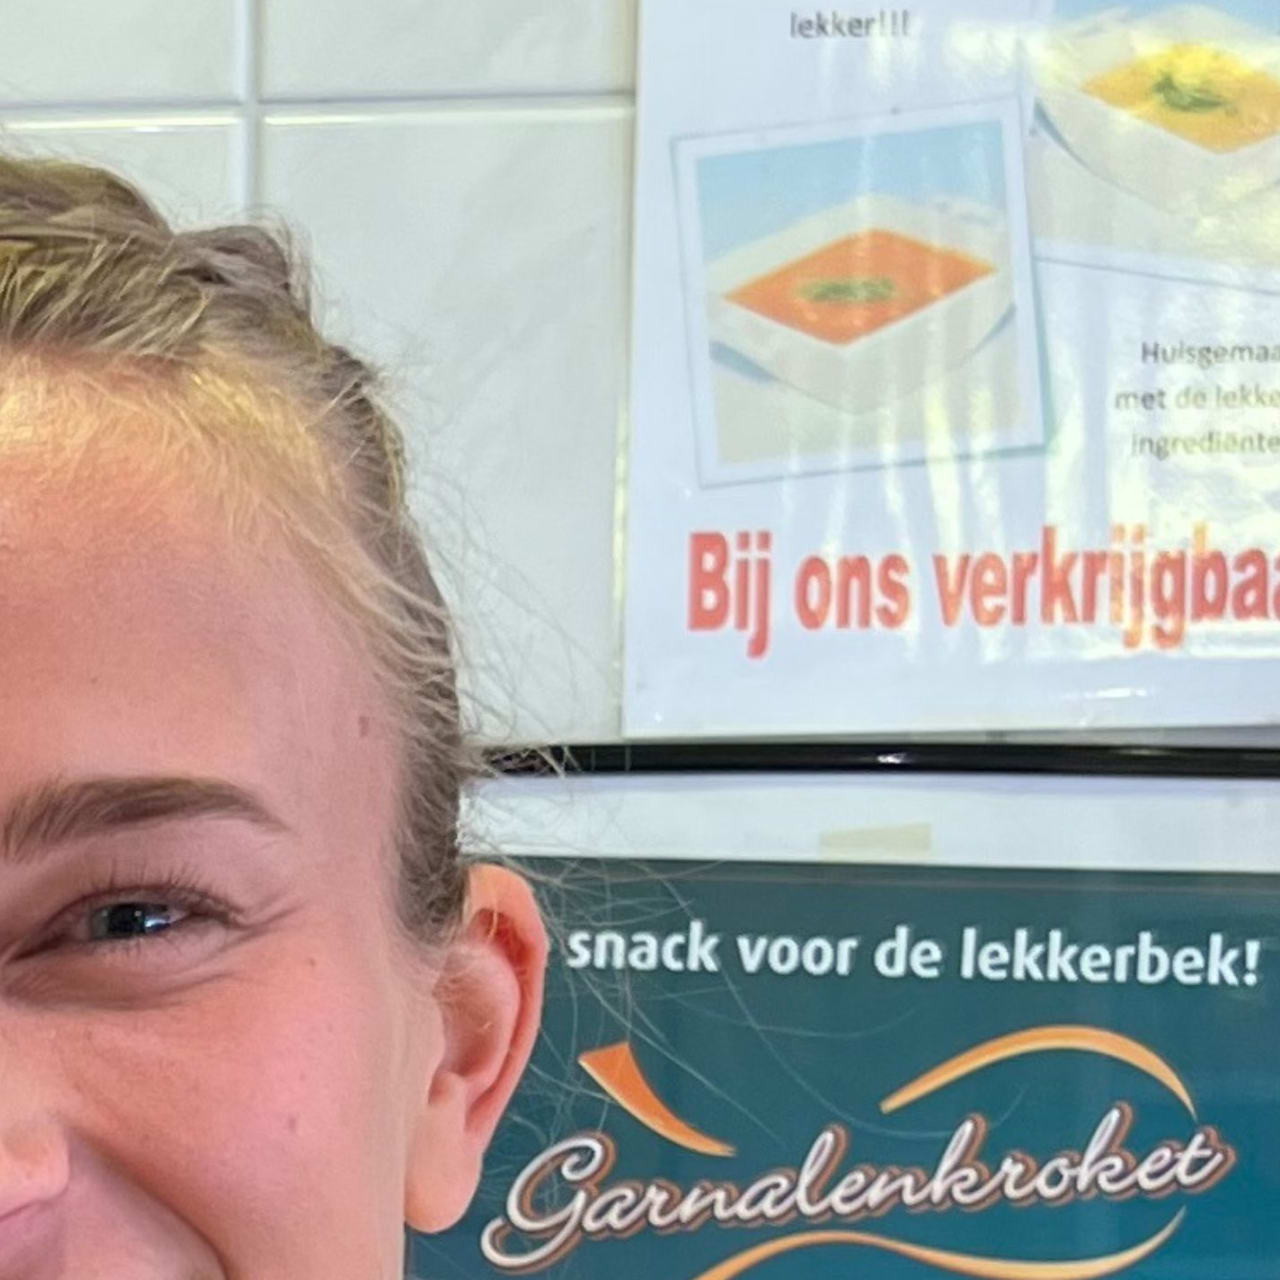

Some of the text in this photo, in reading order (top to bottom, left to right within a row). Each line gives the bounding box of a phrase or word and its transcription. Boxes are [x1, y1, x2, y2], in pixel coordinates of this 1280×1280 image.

[1114, 387, 1167, 411] met
[1175, 384, 1208, 411] de
[688, 522, 1280, 657] Bij ons verkrijgba
[566, 920, 1262, 986] snack voor de lekkerbek!
[479, 1101, 1238, 1276] Garnalenkroket
